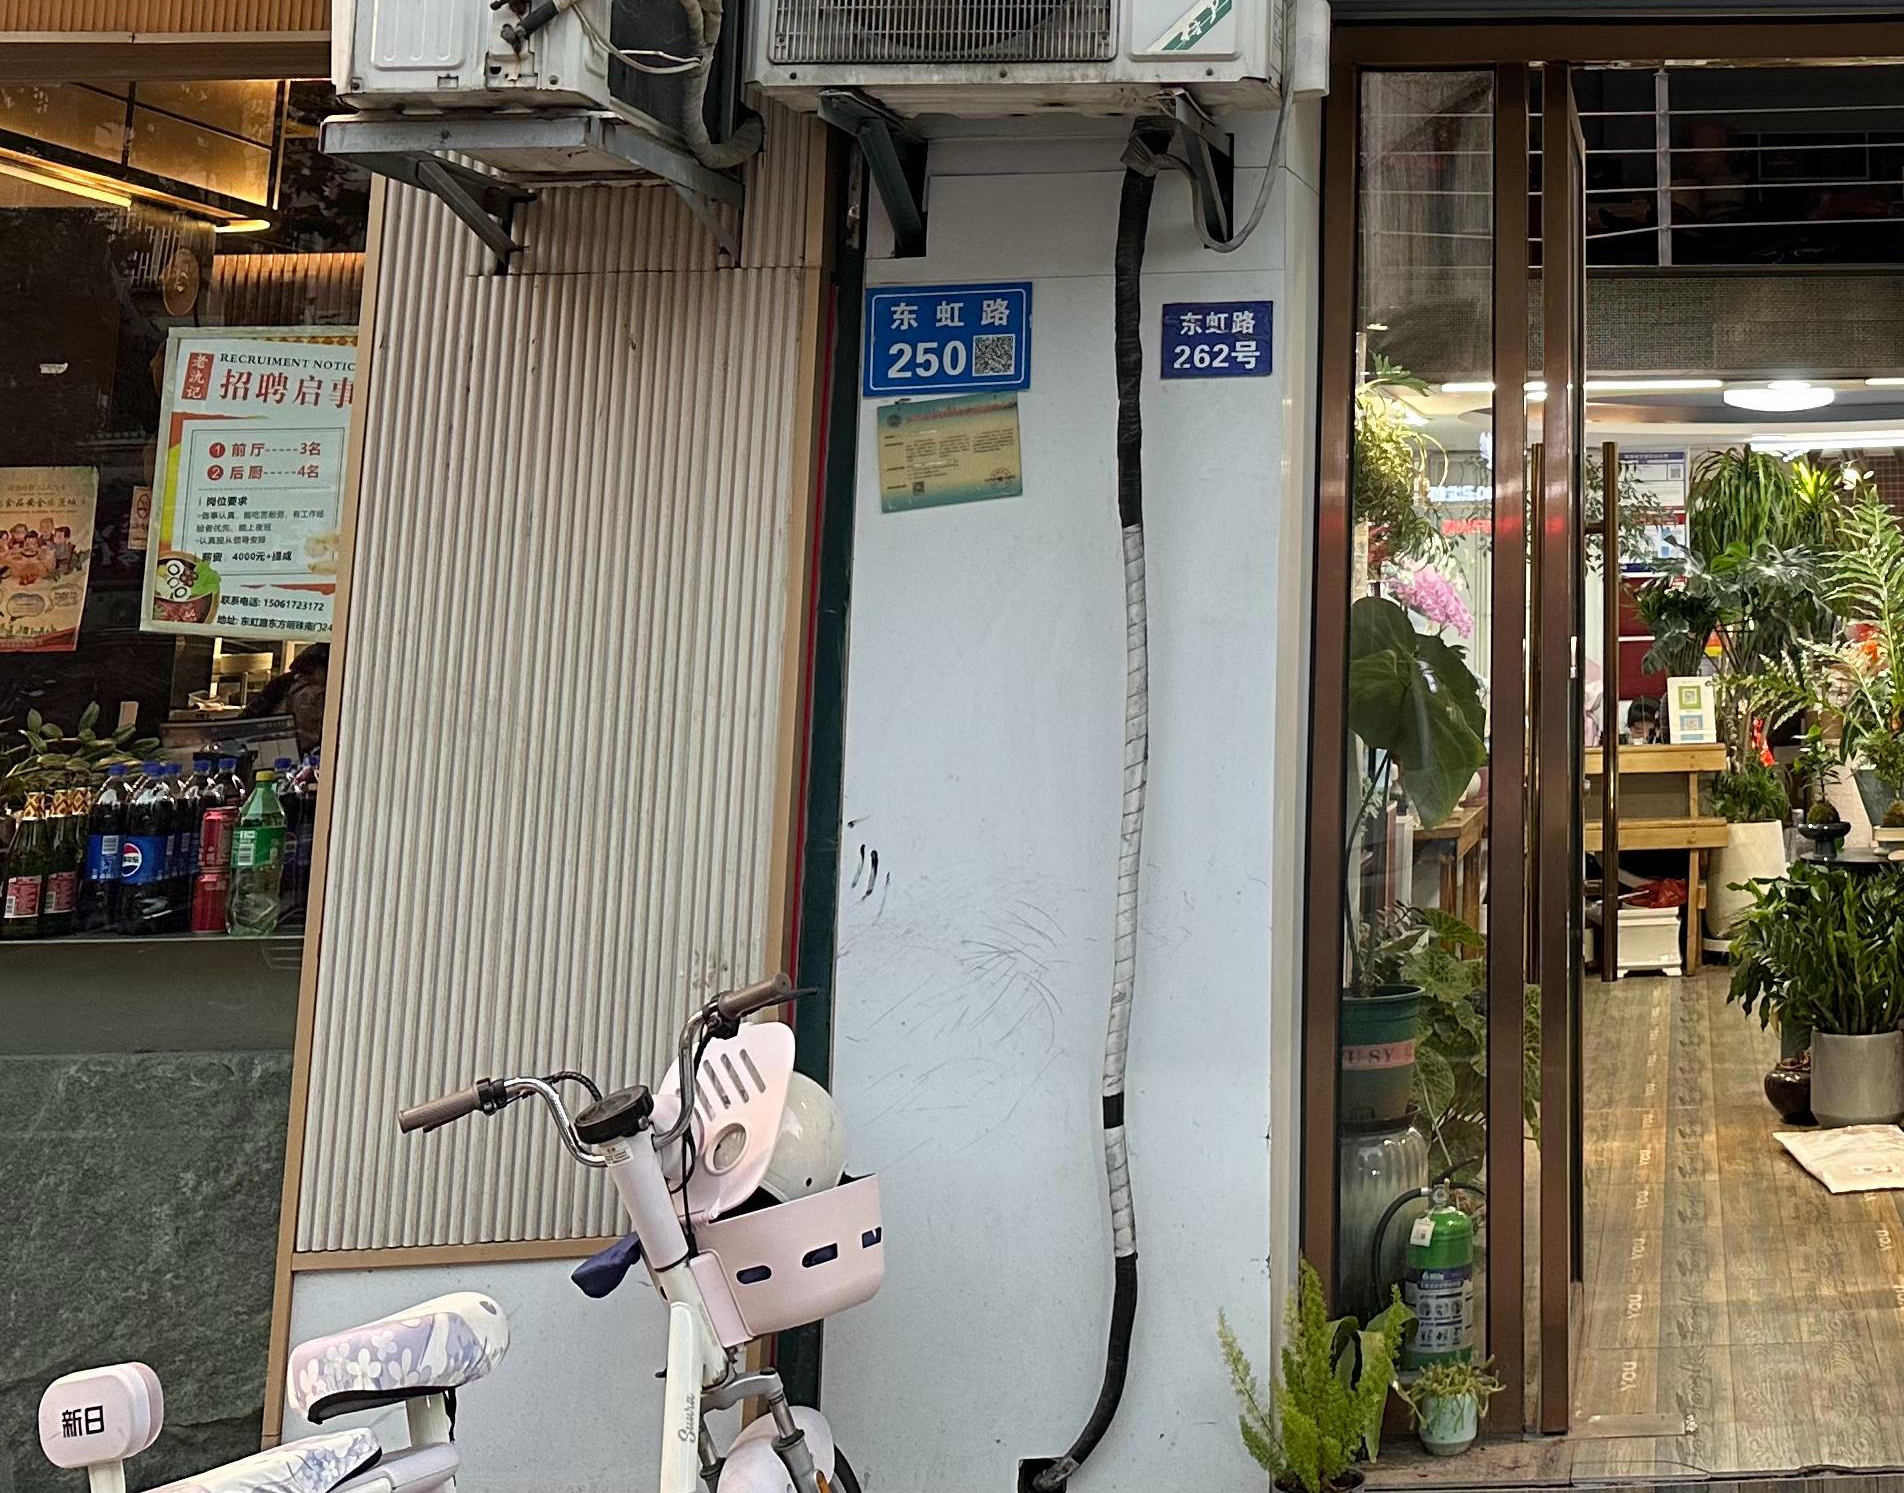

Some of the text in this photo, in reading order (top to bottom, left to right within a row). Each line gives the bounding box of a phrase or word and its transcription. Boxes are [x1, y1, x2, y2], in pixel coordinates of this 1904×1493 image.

[890, 299, 1010, 330] 东虹路
[1179, 311, 1256, 336] 东虹路
[887, 341, 967, 379] 250
[1173, 341, 1260, 369] 262号
[219, 368, 354, 409] 招聘启事
[1620, 1361, 1638, 1392] YOU
[61, 1405, 105, 1438] 新日
